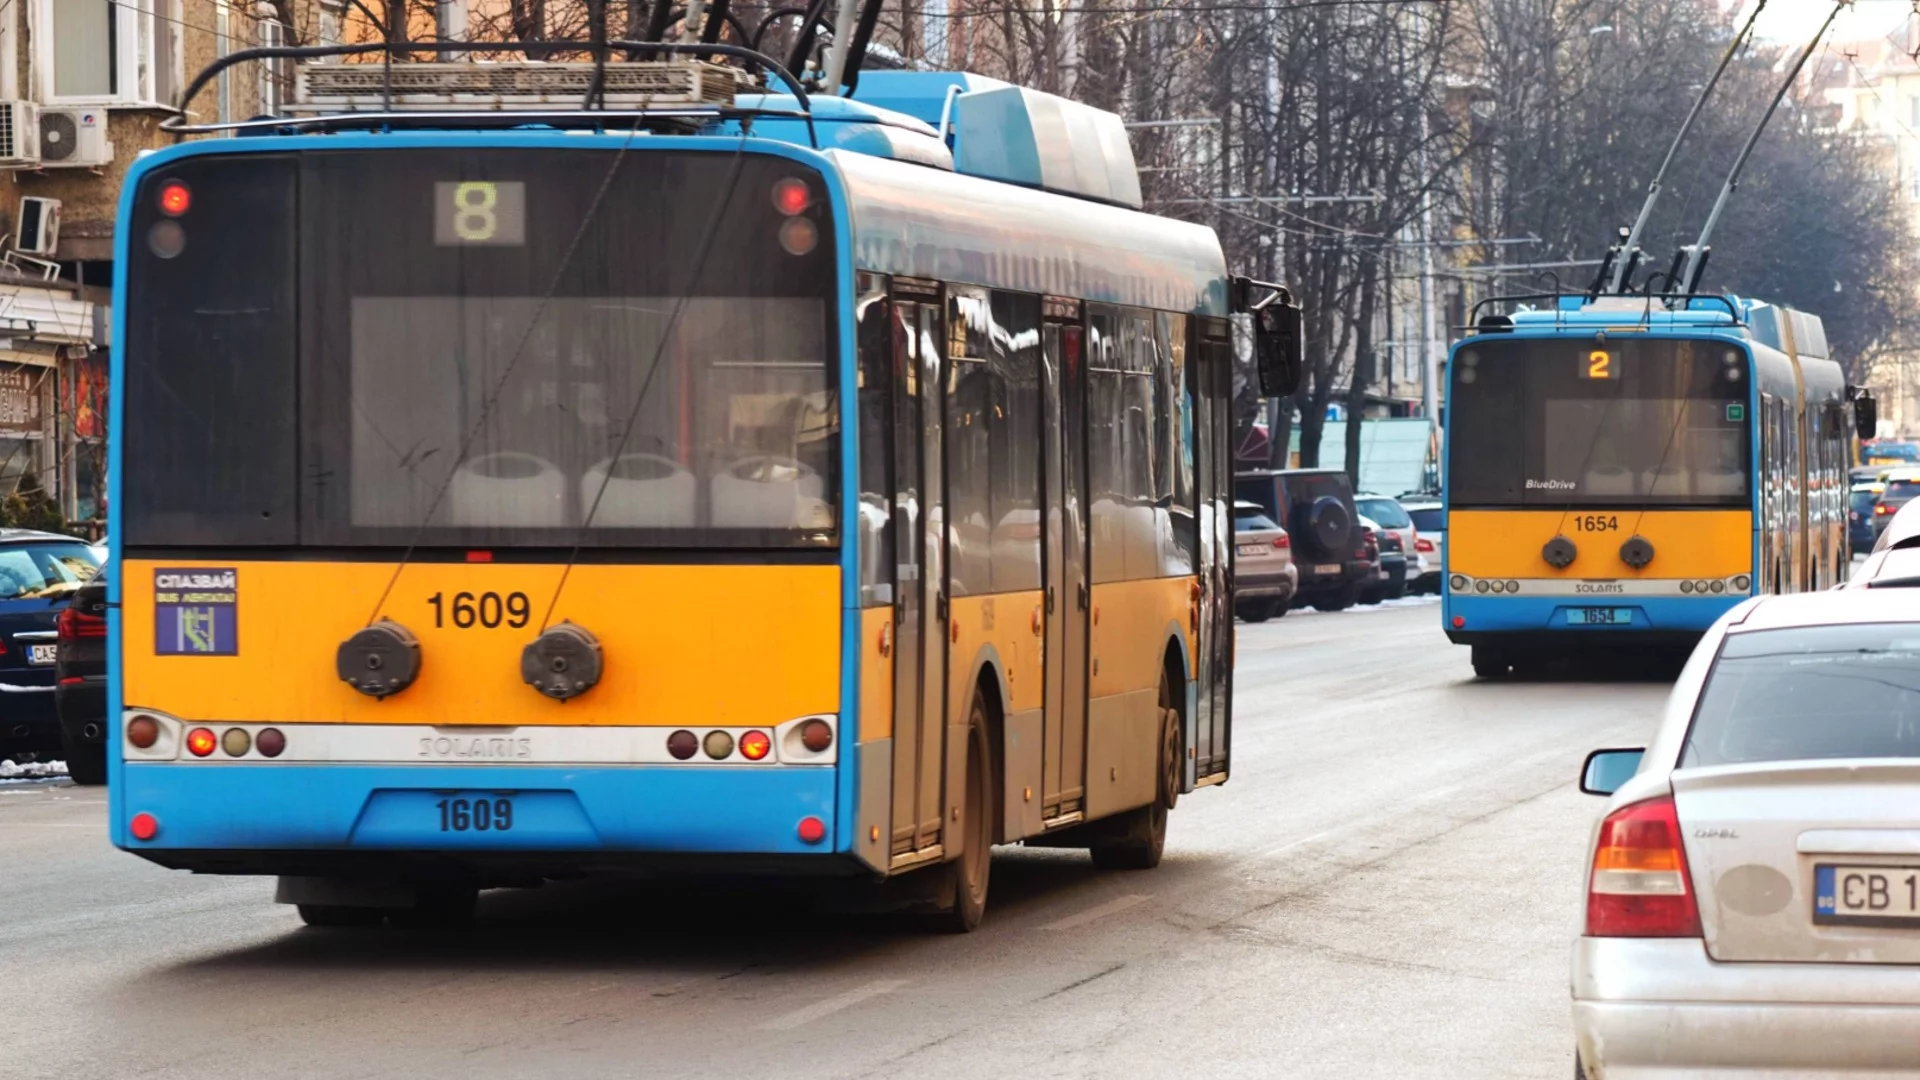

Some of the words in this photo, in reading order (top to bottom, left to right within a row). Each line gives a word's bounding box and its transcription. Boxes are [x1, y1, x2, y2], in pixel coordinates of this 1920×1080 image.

[455, 181, 497, 240] 8
[1589, 351, 1610, 378] 2
[1525, 479, 1576, 490] BlueDrive
[1574, 516, 1618, 532] 1654
[156, 571, 235, 589] СПАЗВАЙ
[1575, 584, 1624, 593] SOLARIS
[427, 591, 531, 629] 1609
[1583, 607, 1616, 623] 1654
[418, 737, 531, 757] SOLARIS
[435, 798, 513, 831] 1609
